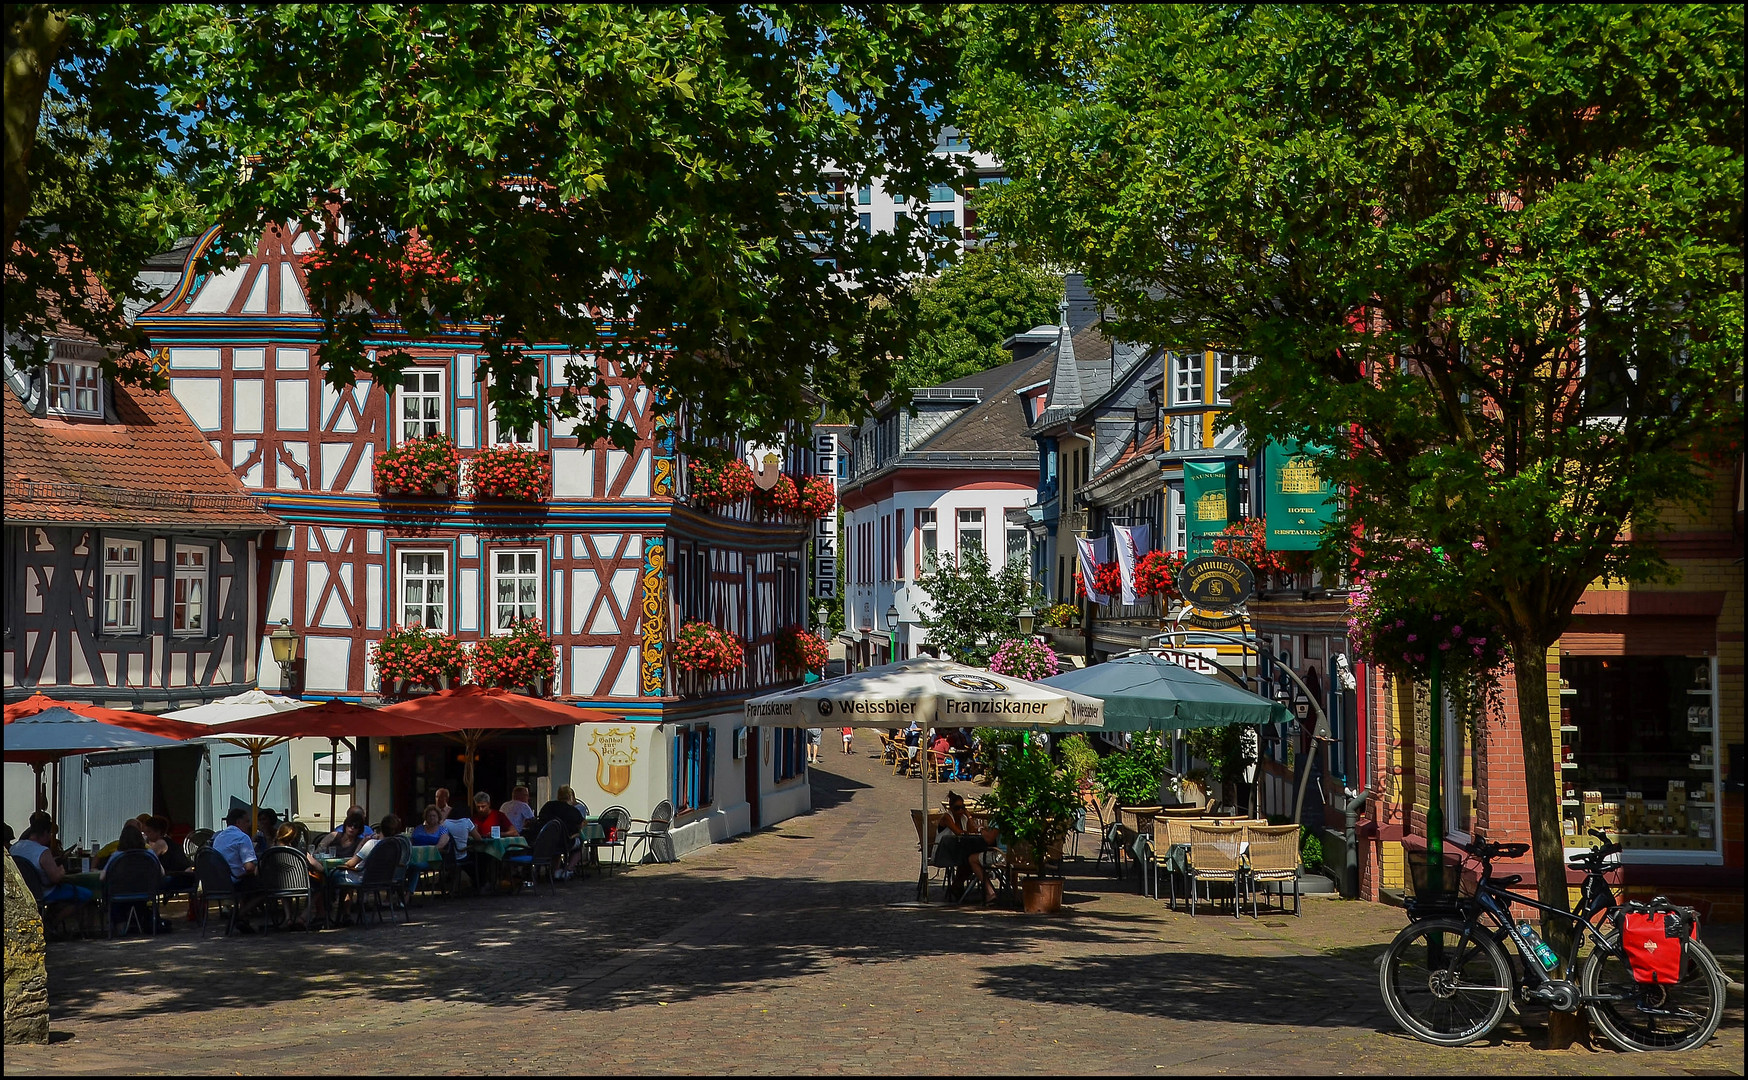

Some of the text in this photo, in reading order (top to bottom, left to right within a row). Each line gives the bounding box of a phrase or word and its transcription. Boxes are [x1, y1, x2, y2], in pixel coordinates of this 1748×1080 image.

[818, 435, 834, 597] SCCKER
[1186, 561, 1246, 580] Taunushof
[1150, 651, 1210, 671] OTEL
[747, 701, 792, 718] Franziskaner
[838, 699, 917, 714] Weissbier
[946, 698, 1048, 714] Franziskaner
[1076, 702, 1099, 718] Weissbier
